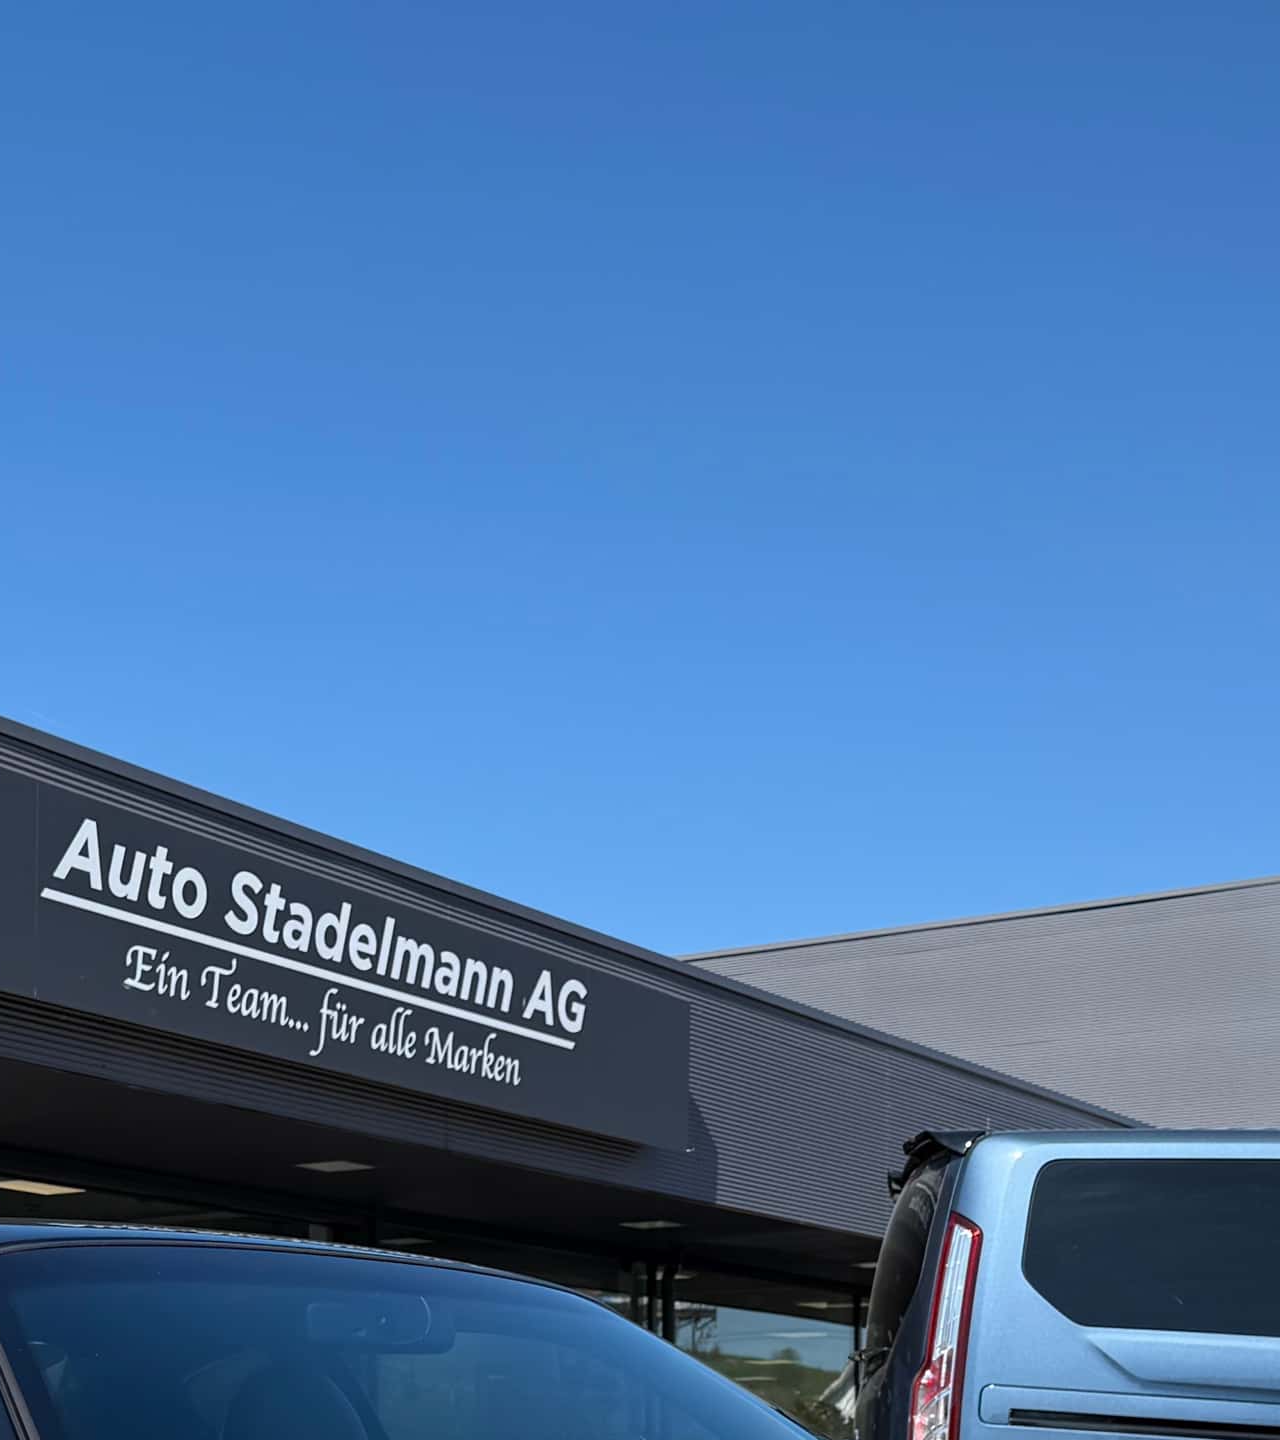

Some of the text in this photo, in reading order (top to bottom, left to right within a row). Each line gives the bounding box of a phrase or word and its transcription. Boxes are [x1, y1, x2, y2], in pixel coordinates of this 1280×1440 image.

[52, 818, 588, 1034] Auto Stadelmann AG
[123, 944, 521, 1086] Ein Team... für alle Marken
